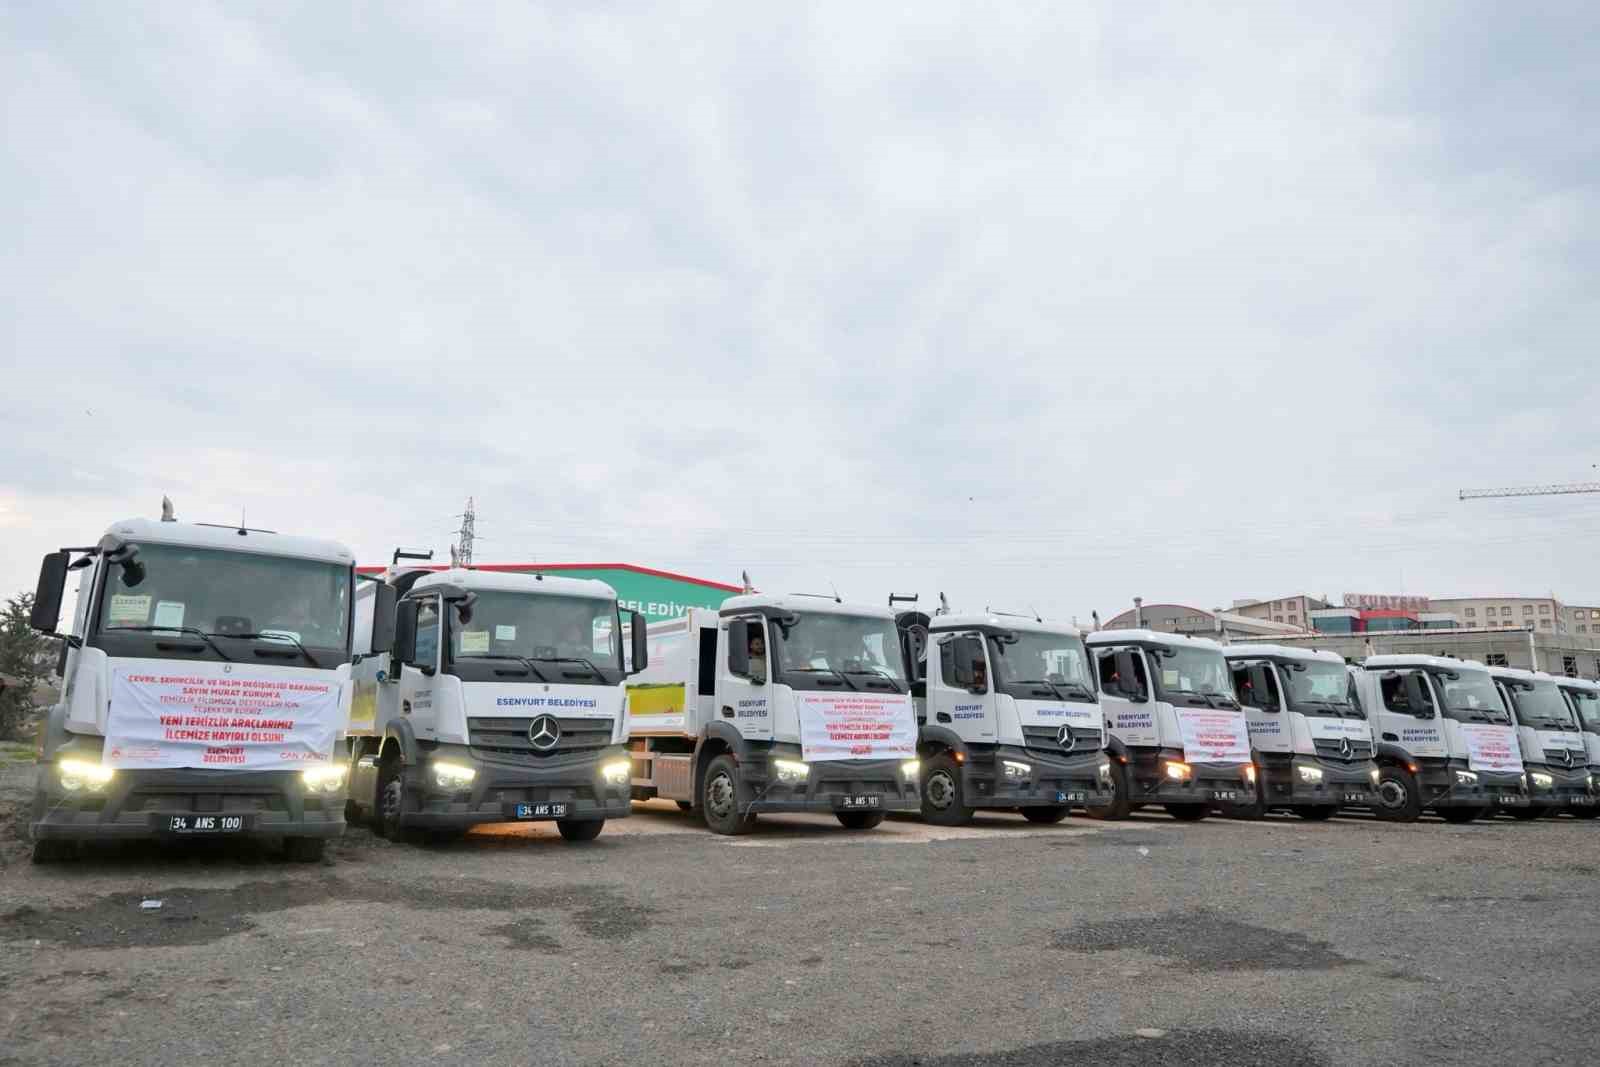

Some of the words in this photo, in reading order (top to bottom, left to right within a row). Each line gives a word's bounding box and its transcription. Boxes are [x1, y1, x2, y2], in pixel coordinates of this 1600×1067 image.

[618, 600, 712, 616] BELEDİY
[183, 687, 209, 695] SAYIN
[211, 688, 240, 696] MURAT
[496, 697, 545, 706] ESENYURT
[547, 697, 597, 708] BELEDİYESİ
[160, 714, 182, 726] YENİ
[185, 716, 229, 727] TEMİZLİK
[230, 719, 294, 730] ARAÇLARIMIZ
[212, 731, 249, 741] HAYIRLI
[523, 805, 533, 815] 34
[535, 805, 549, 815] ANS
[173, 817, 186, 829] 34
[194, 817, 215, 829] ANS
[222, 817, 240, 829] 100
